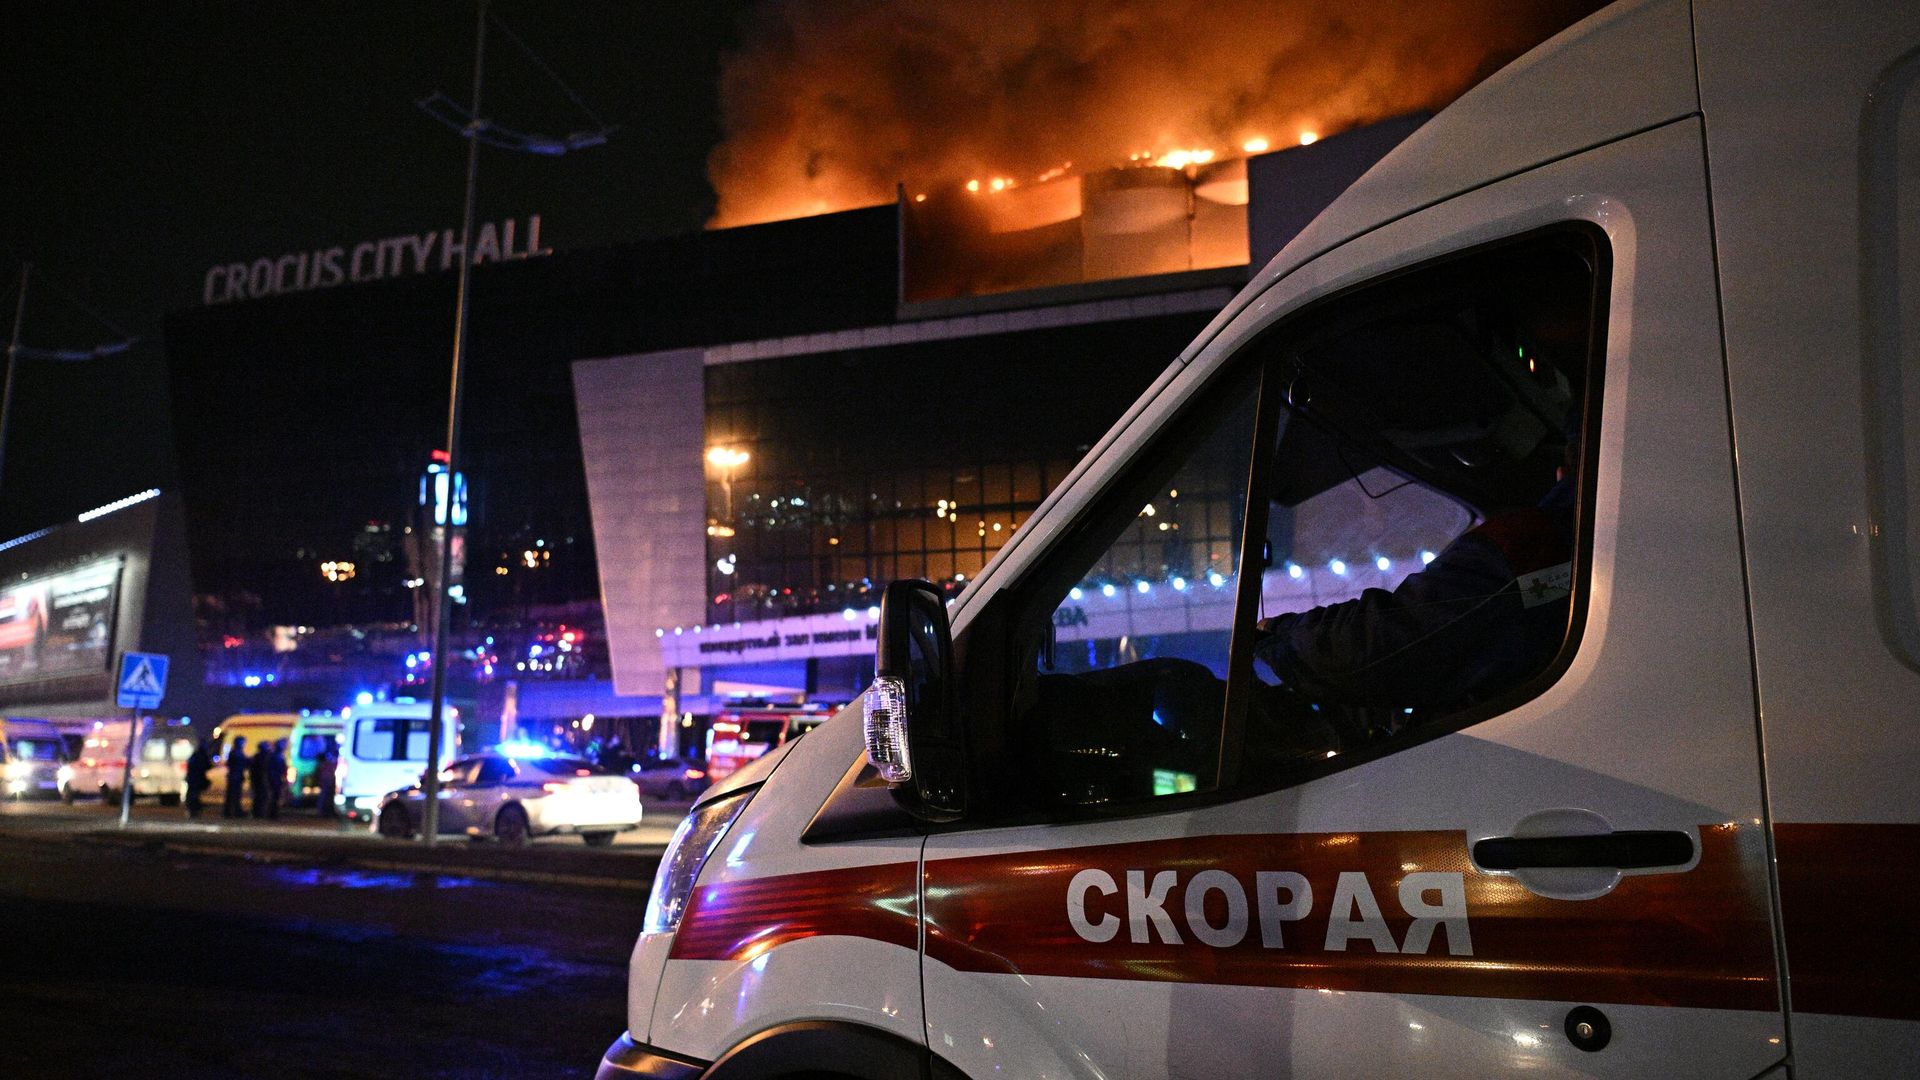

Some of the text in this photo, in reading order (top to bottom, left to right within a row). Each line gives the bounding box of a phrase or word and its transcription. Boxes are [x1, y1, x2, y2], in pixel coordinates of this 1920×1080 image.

[203, 212, 554, 306] CROCUS CITY HALL
[1066, 868, 1474, 956] СКОРАЯ
